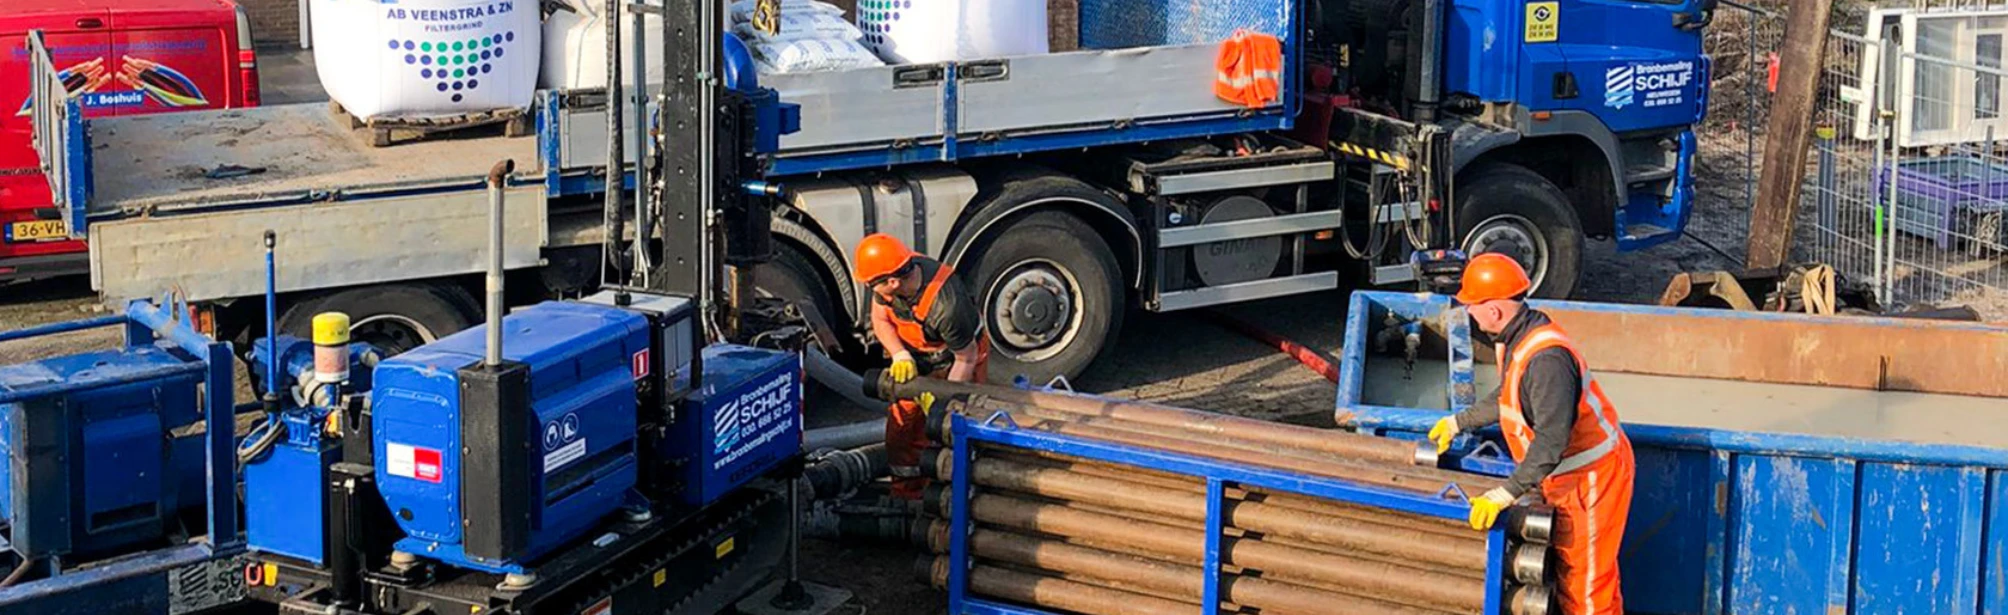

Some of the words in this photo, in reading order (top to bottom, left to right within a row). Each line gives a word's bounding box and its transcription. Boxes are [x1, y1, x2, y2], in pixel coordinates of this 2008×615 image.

[387, 8, 406, 19] AB
[411, 7, 484, 20] VEENSTRA
[487, 4, 495, 15] &
[499, 1, 513, 13] ZN
[425, 21, 483, 32] FILTERGRIND
[1636, 61, 1693, 74] Bronbemaling
[1635, 71, 1692, 90] SCHIJF
[86, 95, 96, 105] J.
[100, 94, 142, 104] Boshuis
[638, 354, 644, 374] 1
[741, 372, 791, 405] Bronbemaling
[741, 383, 792, 423] SCHIJF
